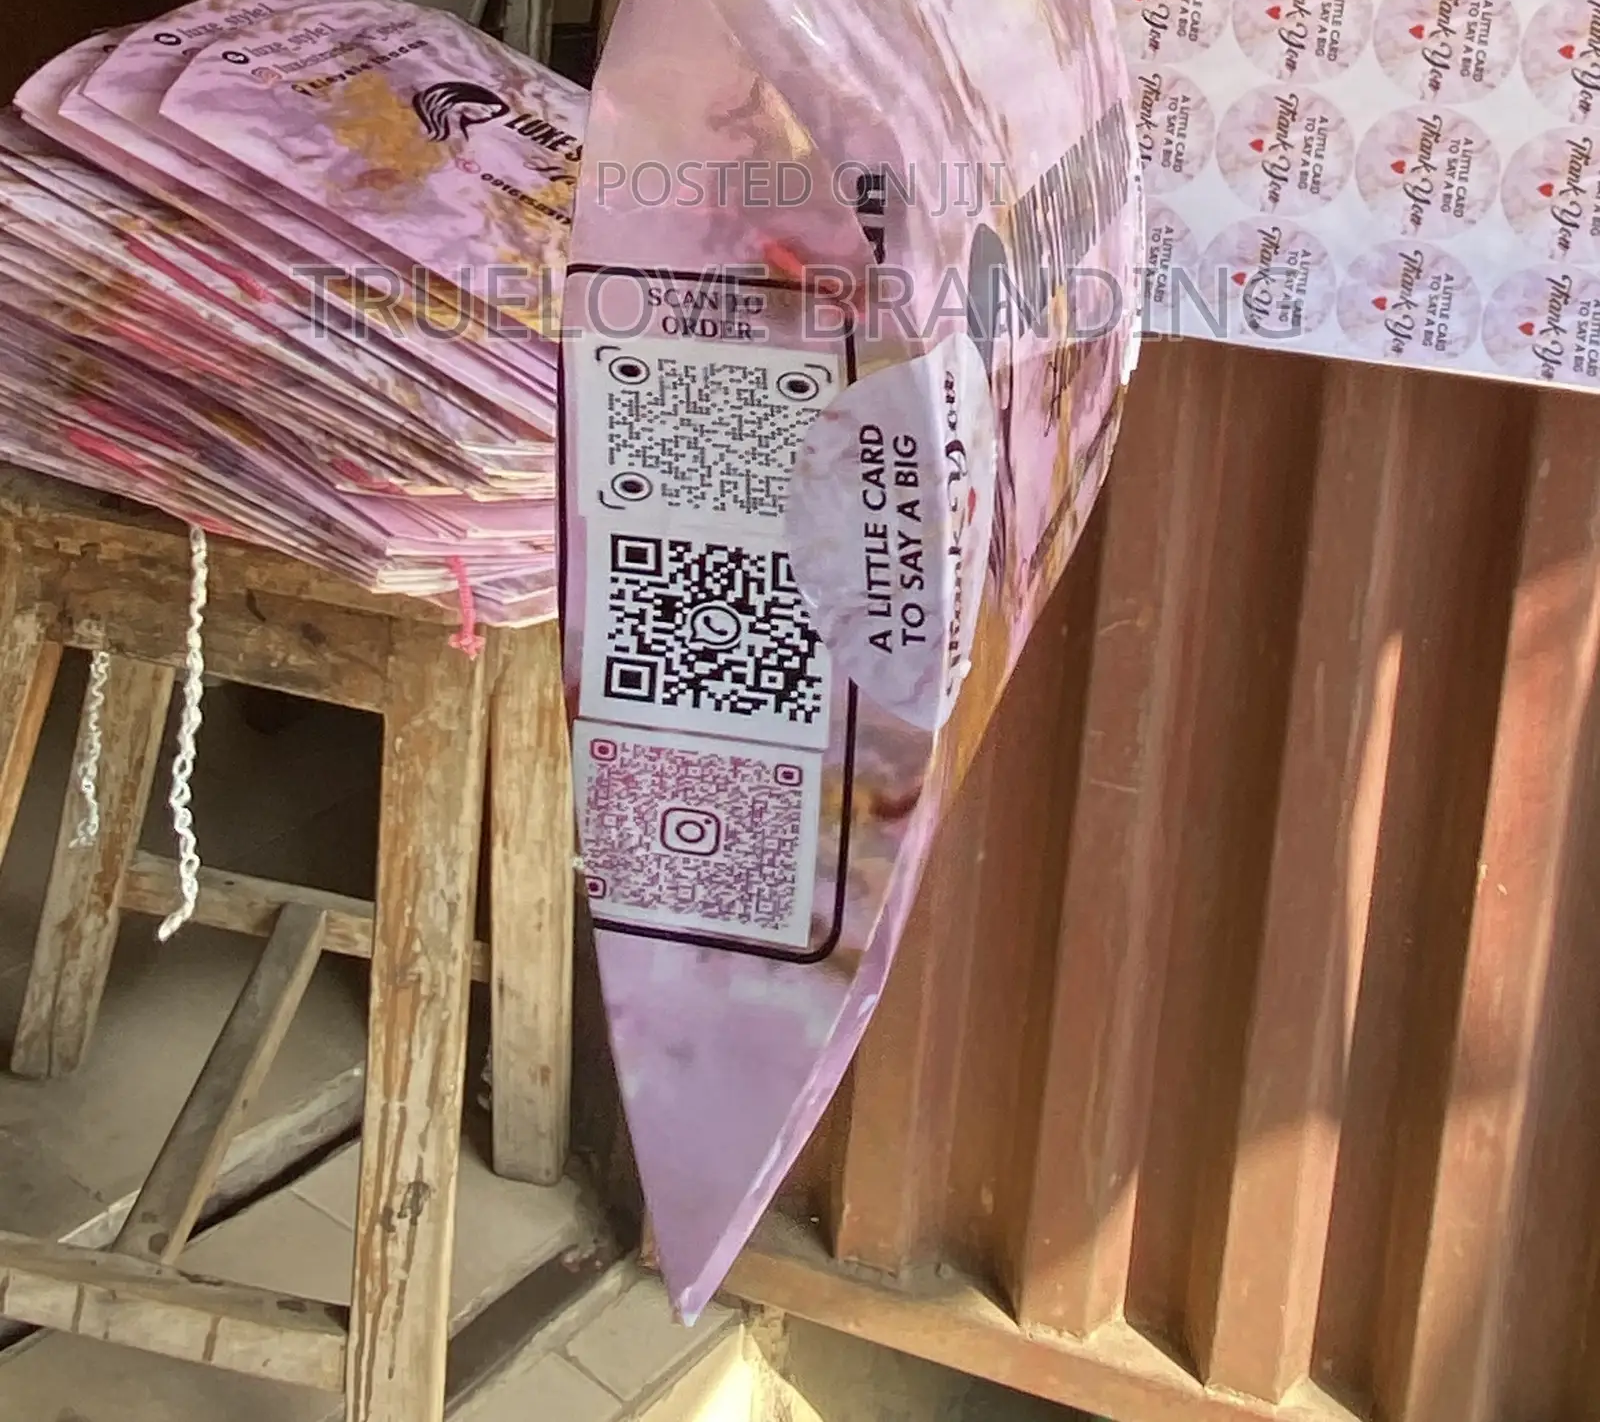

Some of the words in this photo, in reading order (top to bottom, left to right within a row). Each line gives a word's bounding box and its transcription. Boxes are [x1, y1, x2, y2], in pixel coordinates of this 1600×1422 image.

[1468, 0, 1481, 19] TO
[1465, 20, 1478, 43] SAY
[1477, 11, 1492, 47] LITTLE
[1463, 45, 1473, 54] A
[1472, 49, 1487, 83] CARD
[1421, 42, 1453, 94] You
[503, 113, 577, 152] LUXE
[1268, 92, 1299, 152] Thank
[1304, 116, 1317, 134] TO
[1319, 114, 1329, 125] A
[1302, 135, 1314, 157] SAY
[1314, 126, 1328, 161] LITTLE
[1410, 113, 1442, 174] Thank
[1448, 137, 1461, 156] TO
[1463, 136, 1474, 147] A
[1300, 159, 1310, 168] A
[1309, 162, 1323, 195] CARD
[1445, 157, 1458, 180] SAY
[1458, 148, 1473, 184] LITTLE
[1558, 135, 1593, 198] Thank
[1261, 155, 1291, 206] You
[1443, 181, 1454, 190] A
[1402, 178, 1434, 229] You
[1453, 185, 1467, 218] CARD
[1550, 201, 1583, 253] You
[647, 286, 718, 312] SCAN
[725, 292, 764, 316] TO
[662, 315, 753, 341] ORDER
[860, 423, 887, 512] CARD
[893, 433, 918, 489] BIG
[896, 498, 922, 523] A
[864, 522, 892, 618] LITTLE
[897, 529, 925, 591] SAY
[901, 602, 926, 646] TO
[868, 629, 893, 654] A
